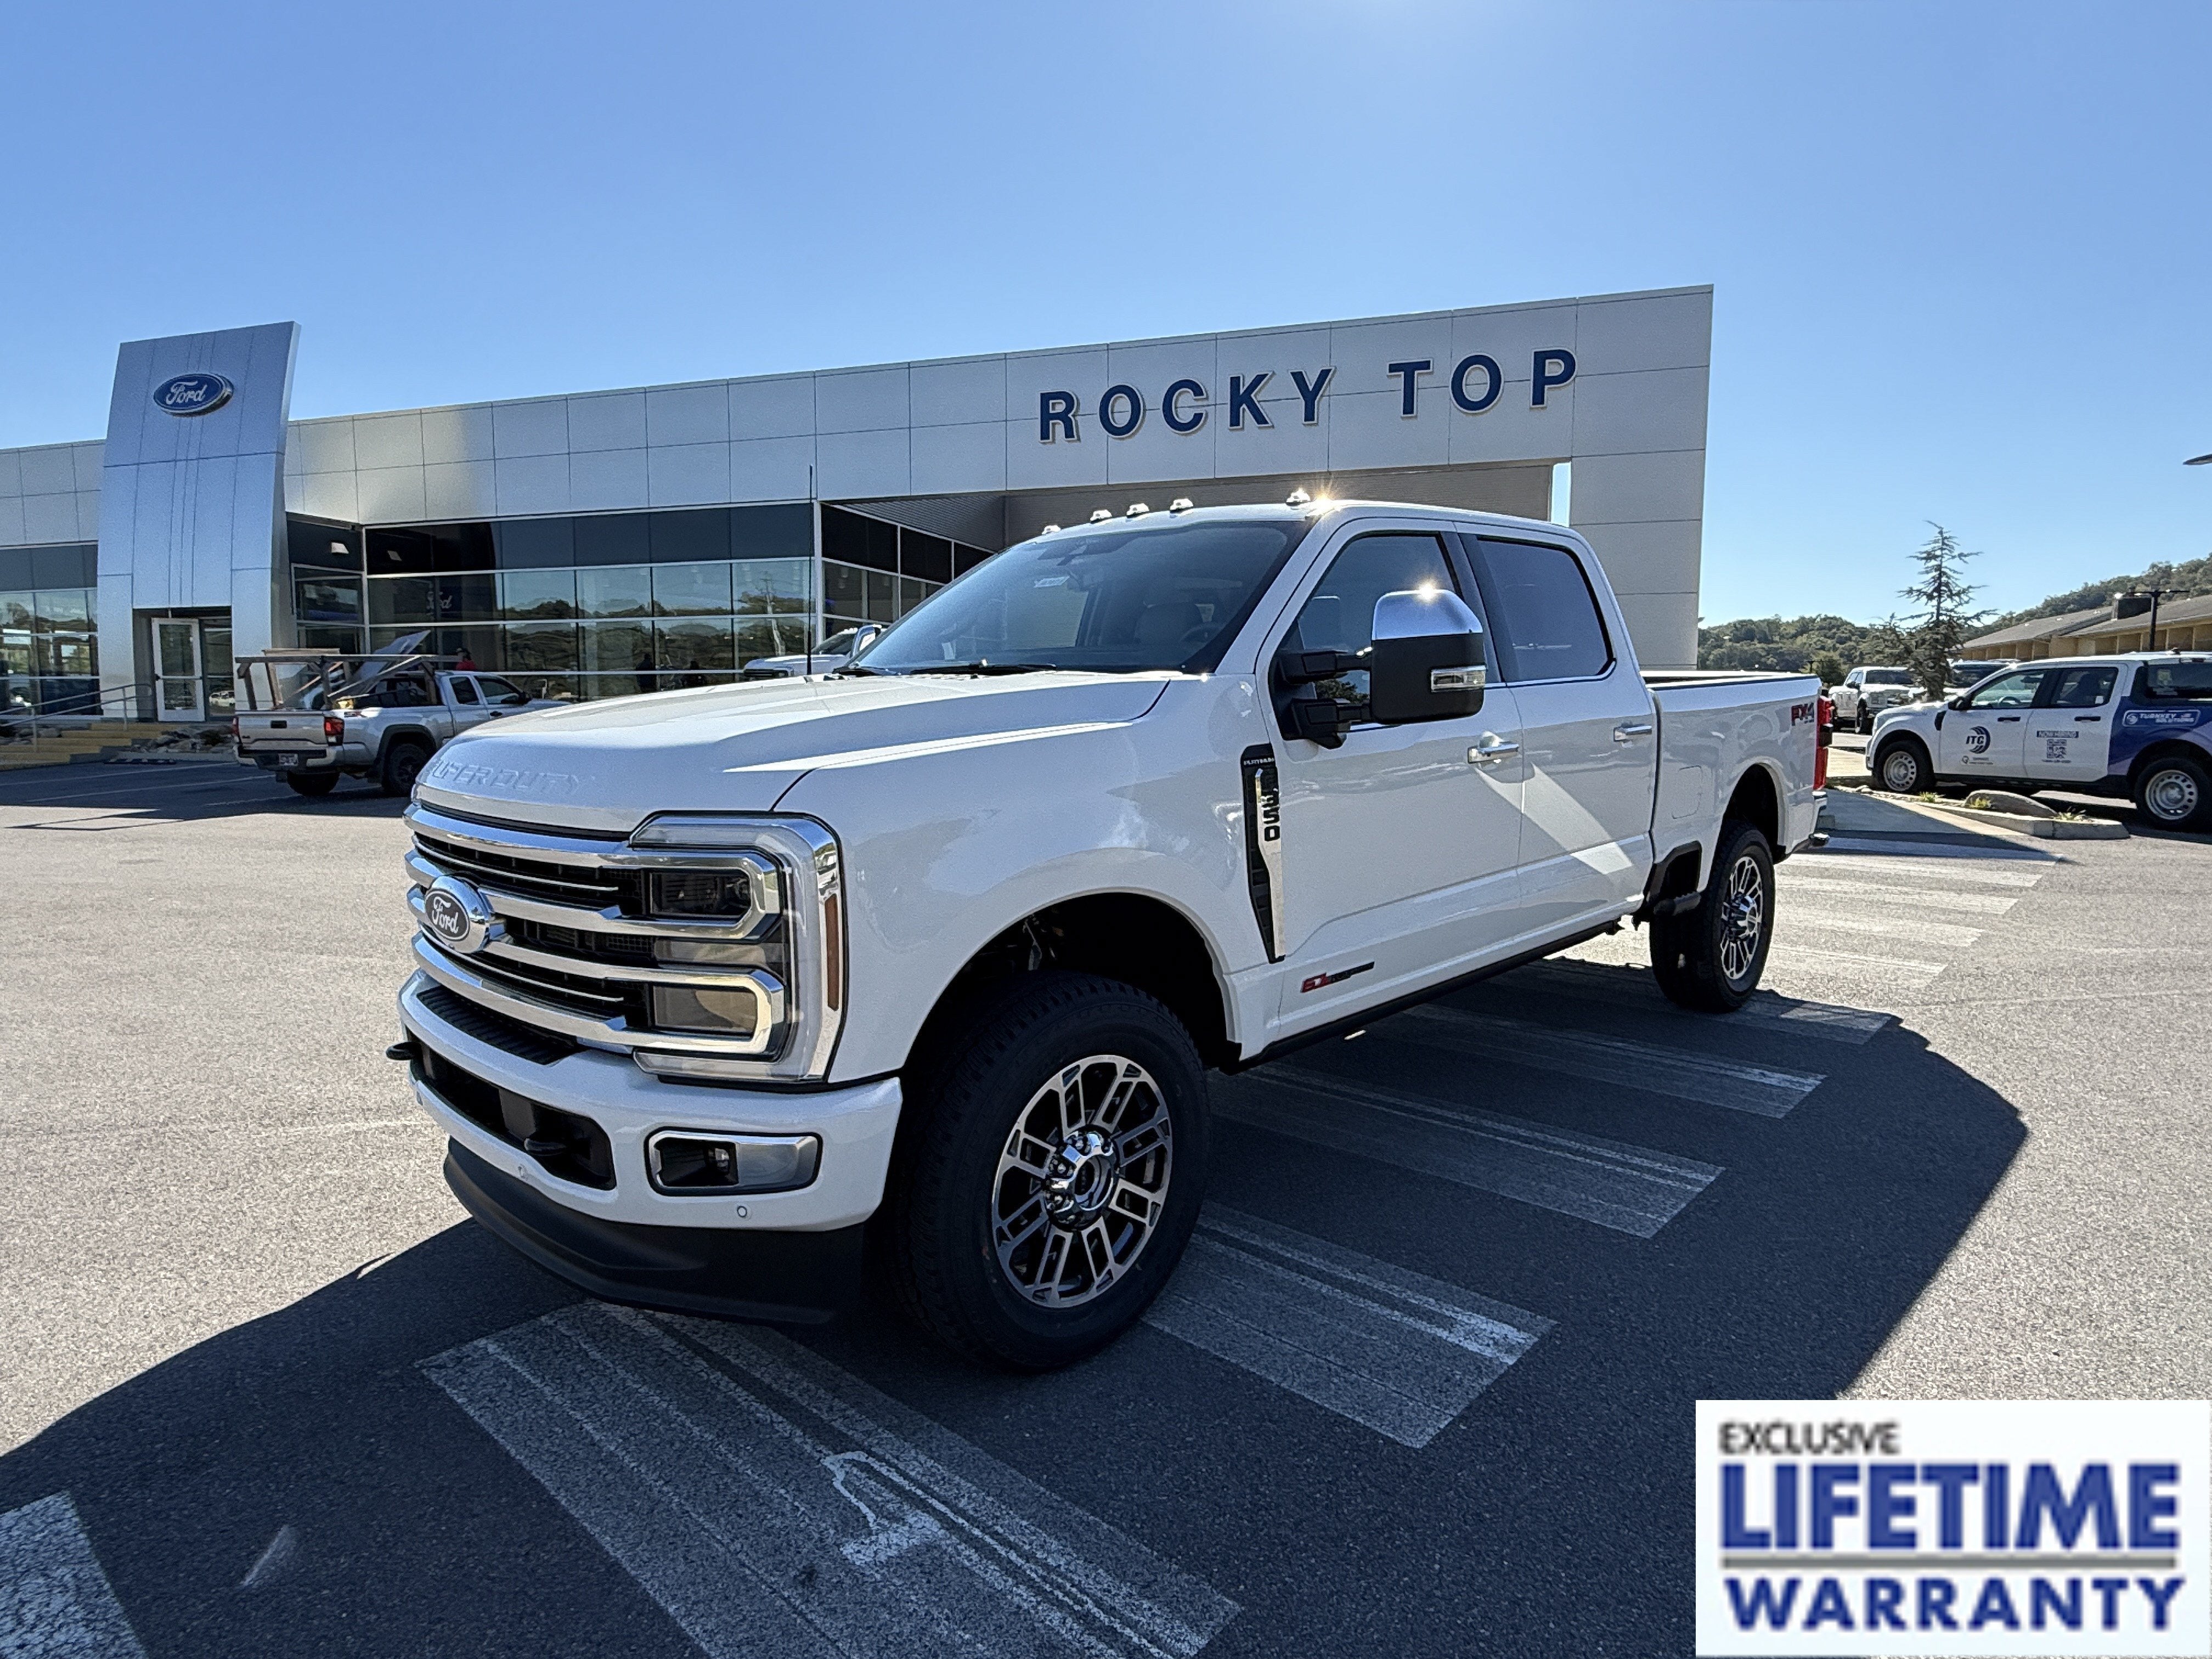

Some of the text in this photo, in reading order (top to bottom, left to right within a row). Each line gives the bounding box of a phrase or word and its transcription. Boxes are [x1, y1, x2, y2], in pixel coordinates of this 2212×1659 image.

[166, 381, 207, 405] Ford
[1039, 348, 1577, 443] ROCKY TOP
[427, 591, 453, 609] Fd
[1966, 735, 1985, 744] ITC
[431, 896, 460, 934] Ford
